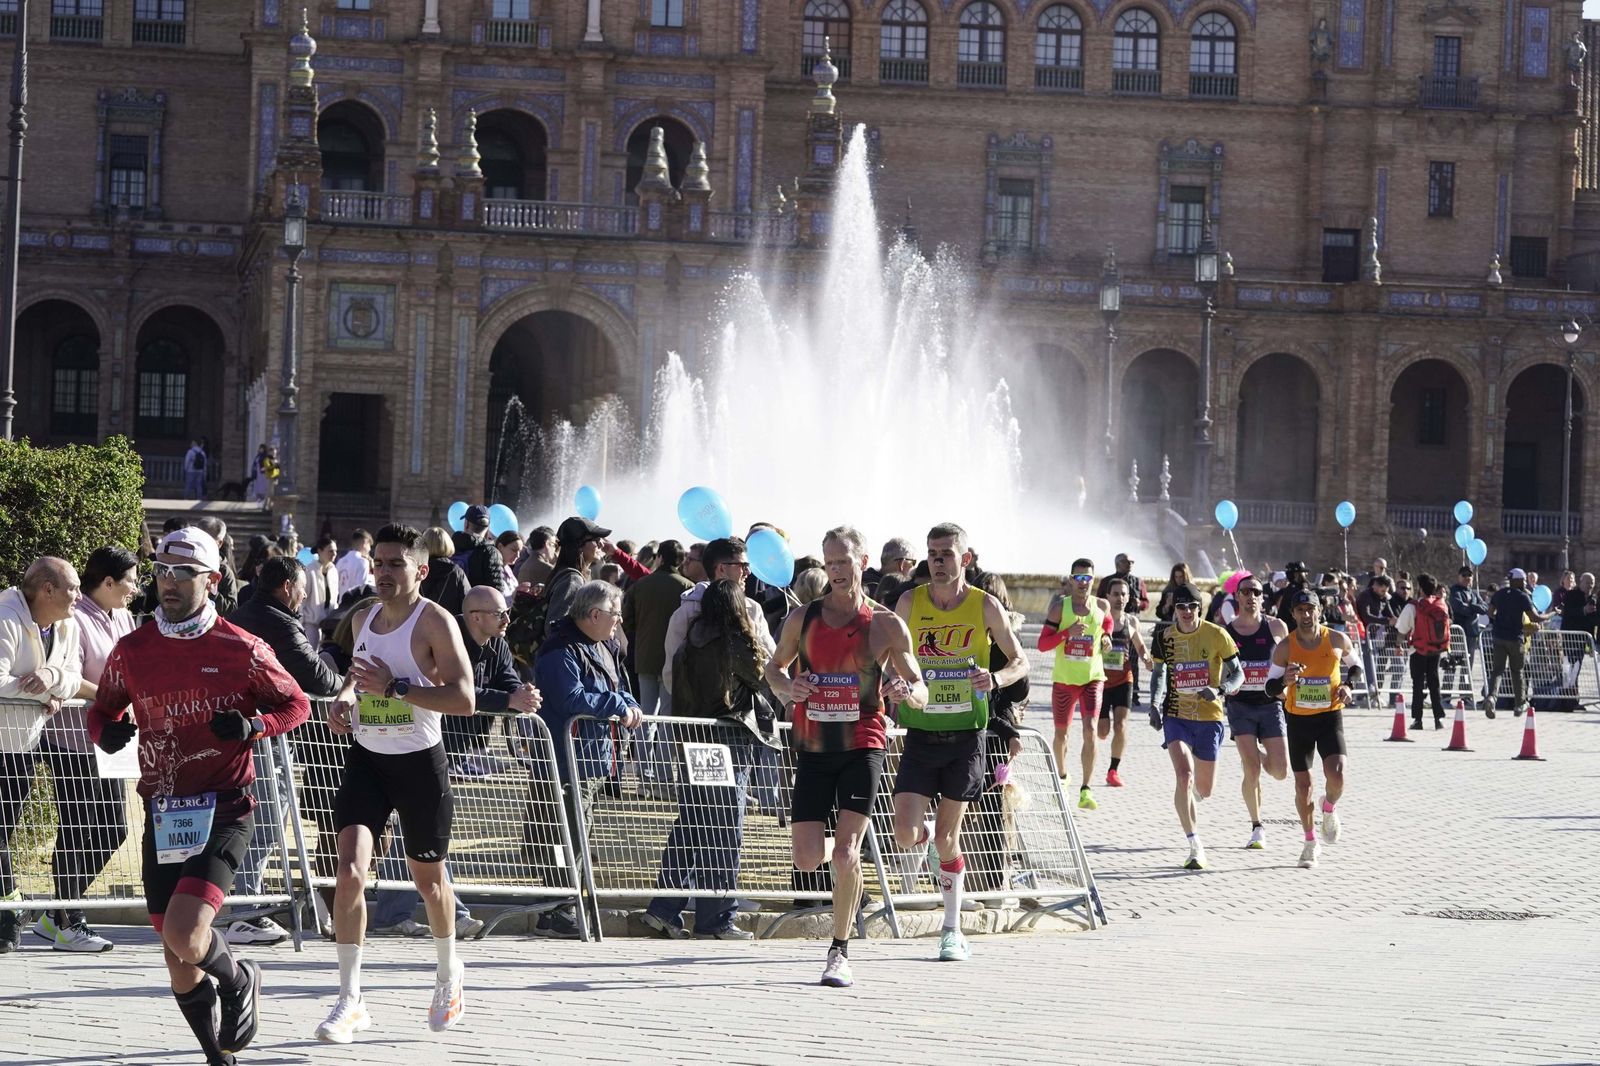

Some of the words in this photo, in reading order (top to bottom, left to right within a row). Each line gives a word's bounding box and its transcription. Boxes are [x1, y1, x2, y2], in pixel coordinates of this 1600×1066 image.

[822, 676, 852, 684] ZURICH
[1176, 678, 1209, 688] MAURYCY
[152, 687, 209, 707] MEDIO
[823, 690, 840, 698] 1229
[935, 693, 960, 703] CLEM
[1300, 693, 1327, 701] PARADA
[165, 691, 244, 717] MARATÓN
[372, 699, 389, 708] 1749
[808, 701, 825, 711] NIELS
[827, 702, 860, 711] MARTIJN
[385, 713, 414, 724] ÁNGEL
[171, 797, 209, 809] ZURICH
[172, 818, 193, 828] 7366
[168, 831, 201, 847] MANU
